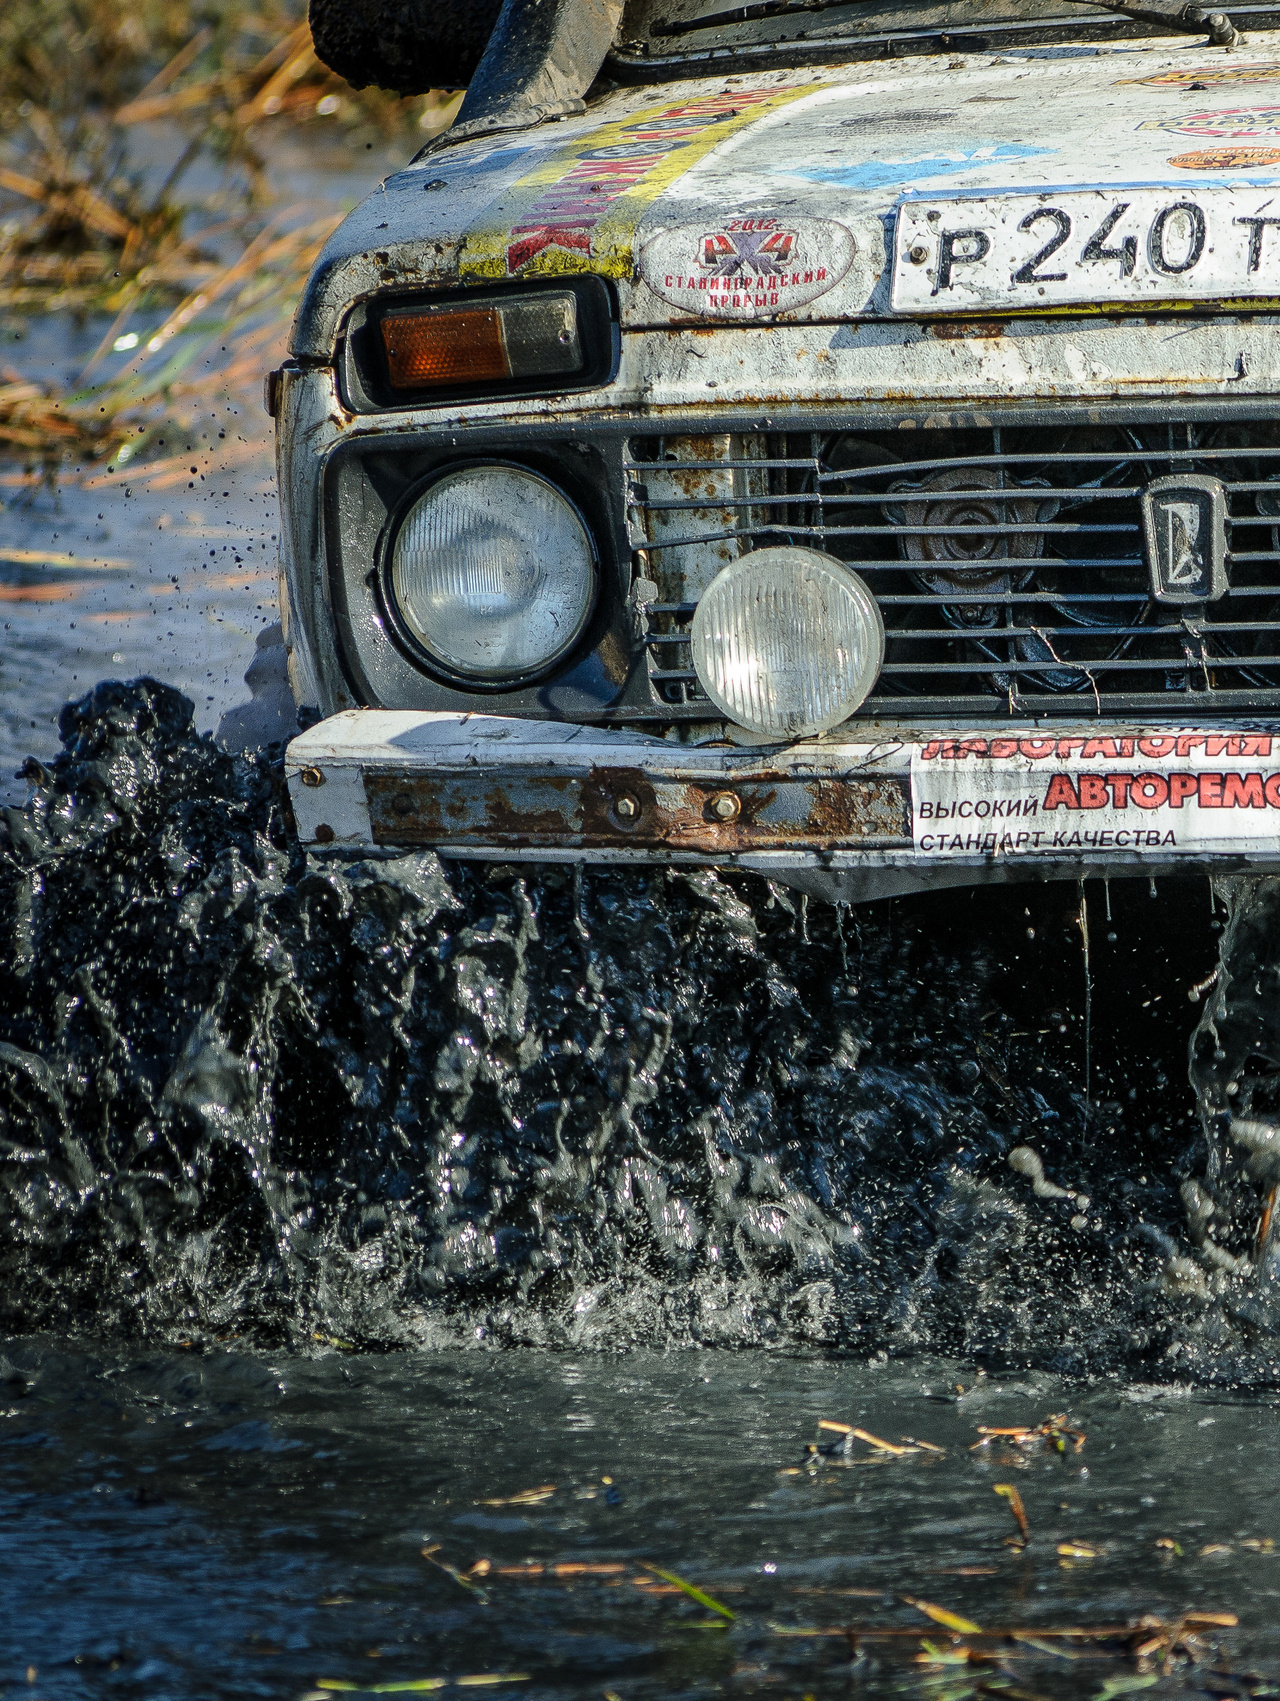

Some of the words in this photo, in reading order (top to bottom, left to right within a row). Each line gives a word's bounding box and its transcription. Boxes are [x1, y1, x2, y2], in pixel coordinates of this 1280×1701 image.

[728, 218, 778, 232] 2012
[709, 292, 780, 309] ПРОРЫВ
[919, 732, 1273, 760] ЛАБОРАТОРИЯ
[918, 795, 1039, 820] ВЫСОКИЙ
[918, 831, 1048, 854] СТАНДАРТ
[1051, 829, 1178, 849] КАЧЕСТВА
